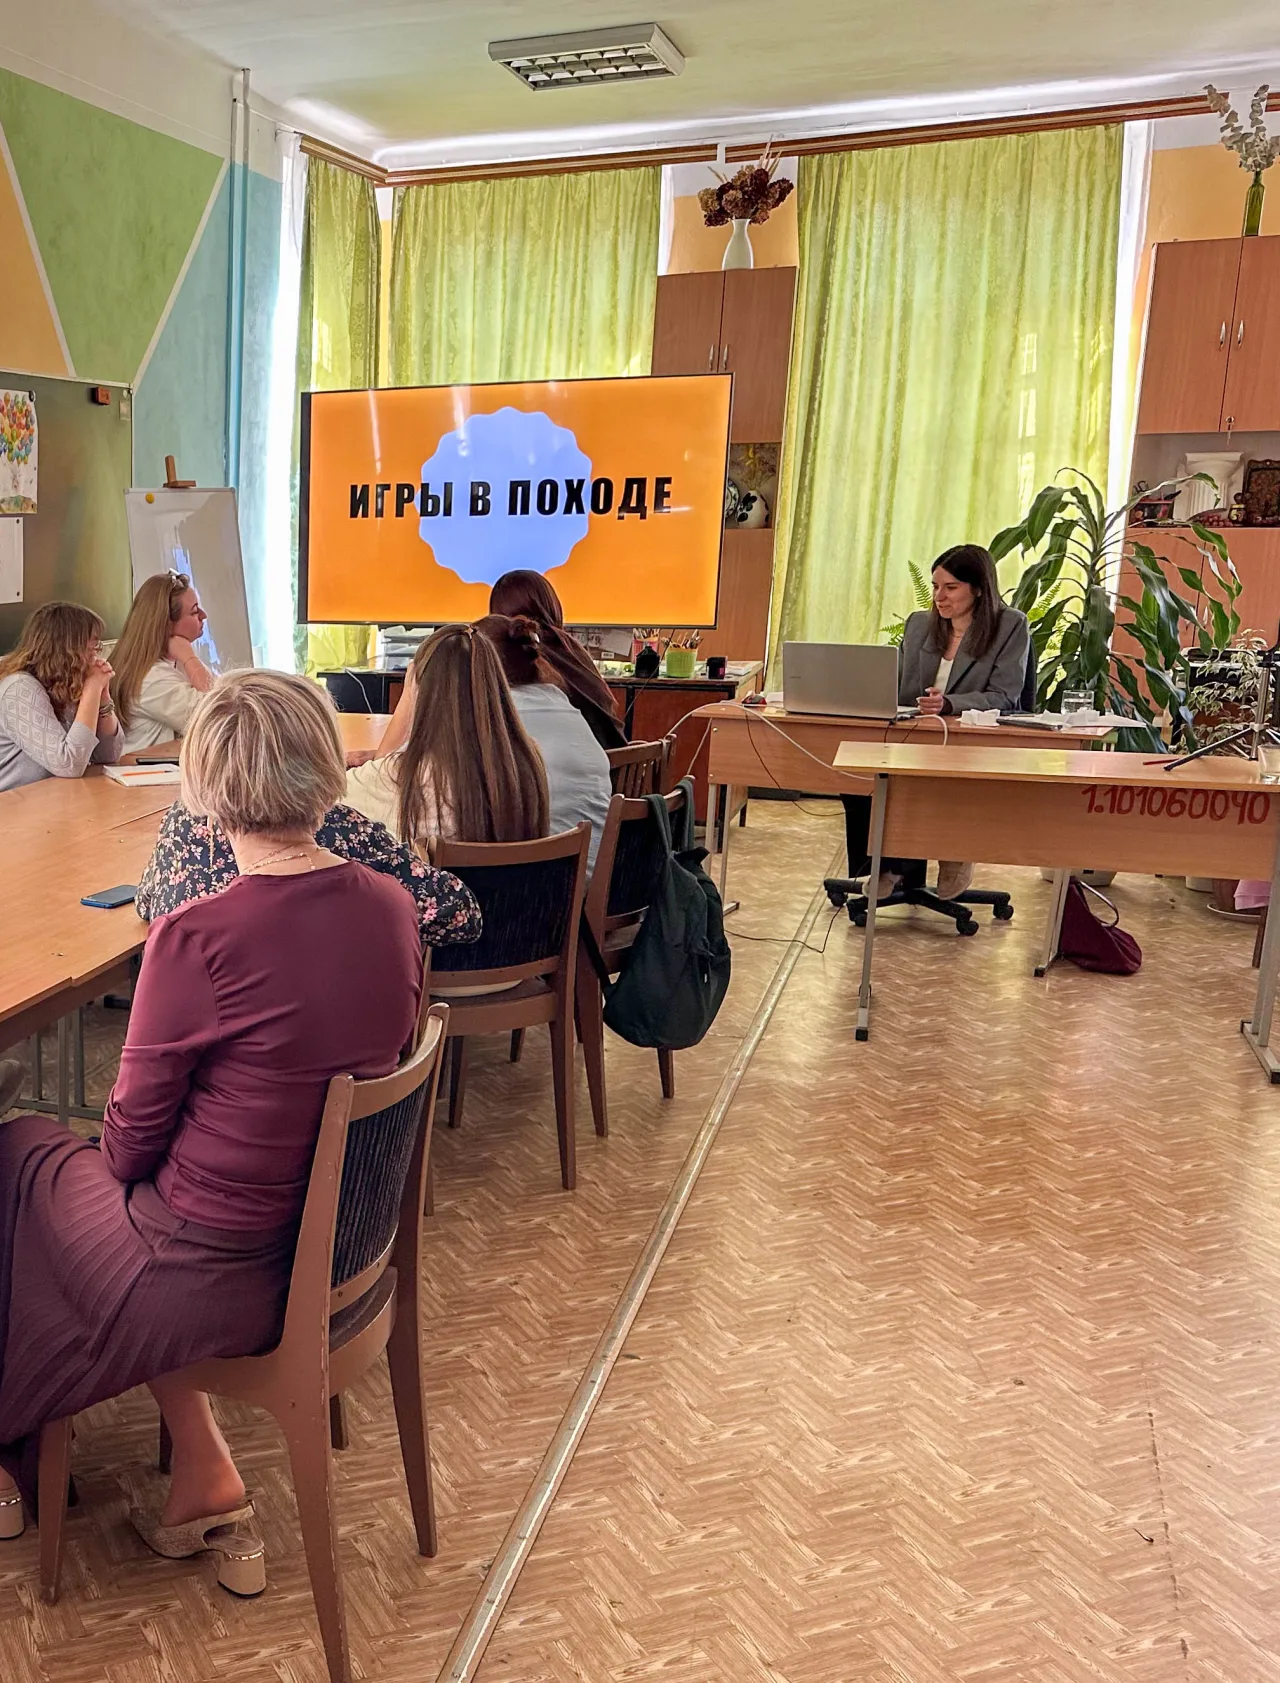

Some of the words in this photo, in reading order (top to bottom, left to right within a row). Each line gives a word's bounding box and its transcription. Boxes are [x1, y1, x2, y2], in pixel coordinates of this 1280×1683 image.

[349, 482, 453, 518] ИГРЫ
[469, 481, 491, 516] В
[508, 477, 673, 520] ПОХОДЕ
